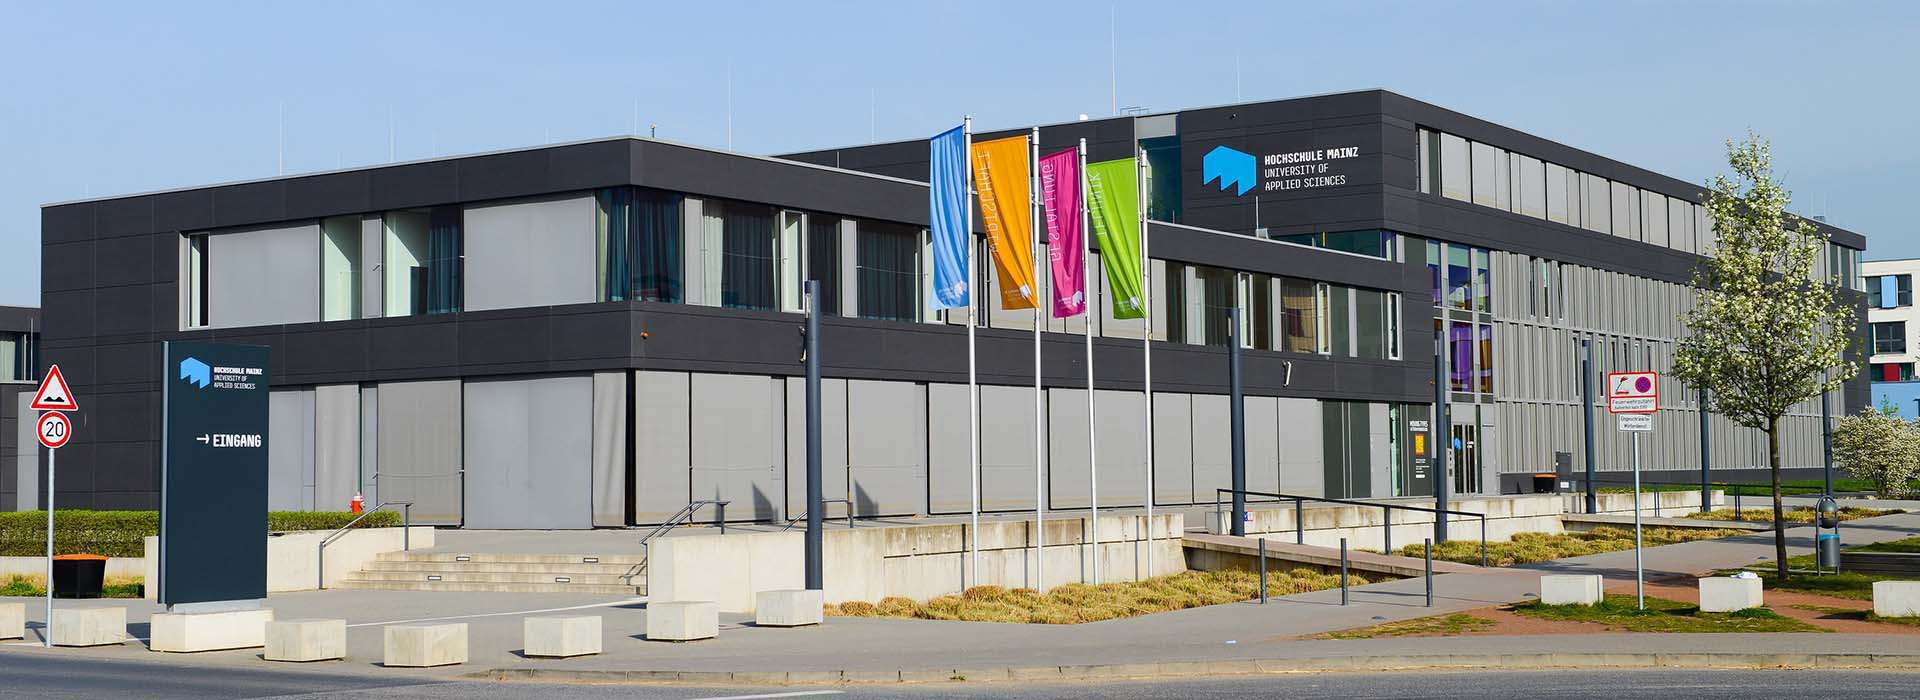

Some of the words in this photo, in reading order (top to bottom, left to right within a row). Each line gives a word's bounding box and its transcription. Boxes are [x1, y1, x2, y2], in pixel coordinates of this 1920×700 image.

[1264, 150, 1323, 166] HOCHSCHULE
[1326, 147, 1359, 160] MAINZ
[1264, 165, 1315, 178] UNIVERSITY
[1318, 163, 1329, 173] OF
[1265, 178, 1301, 191] APPLIED
[1303, 175, 1346, 188] SCIENCES
[213, 367, 245, 375] HOCHSCHULE
[45, 421, 64, 437] 20
[213, 434, 262, 447] EINGANG
